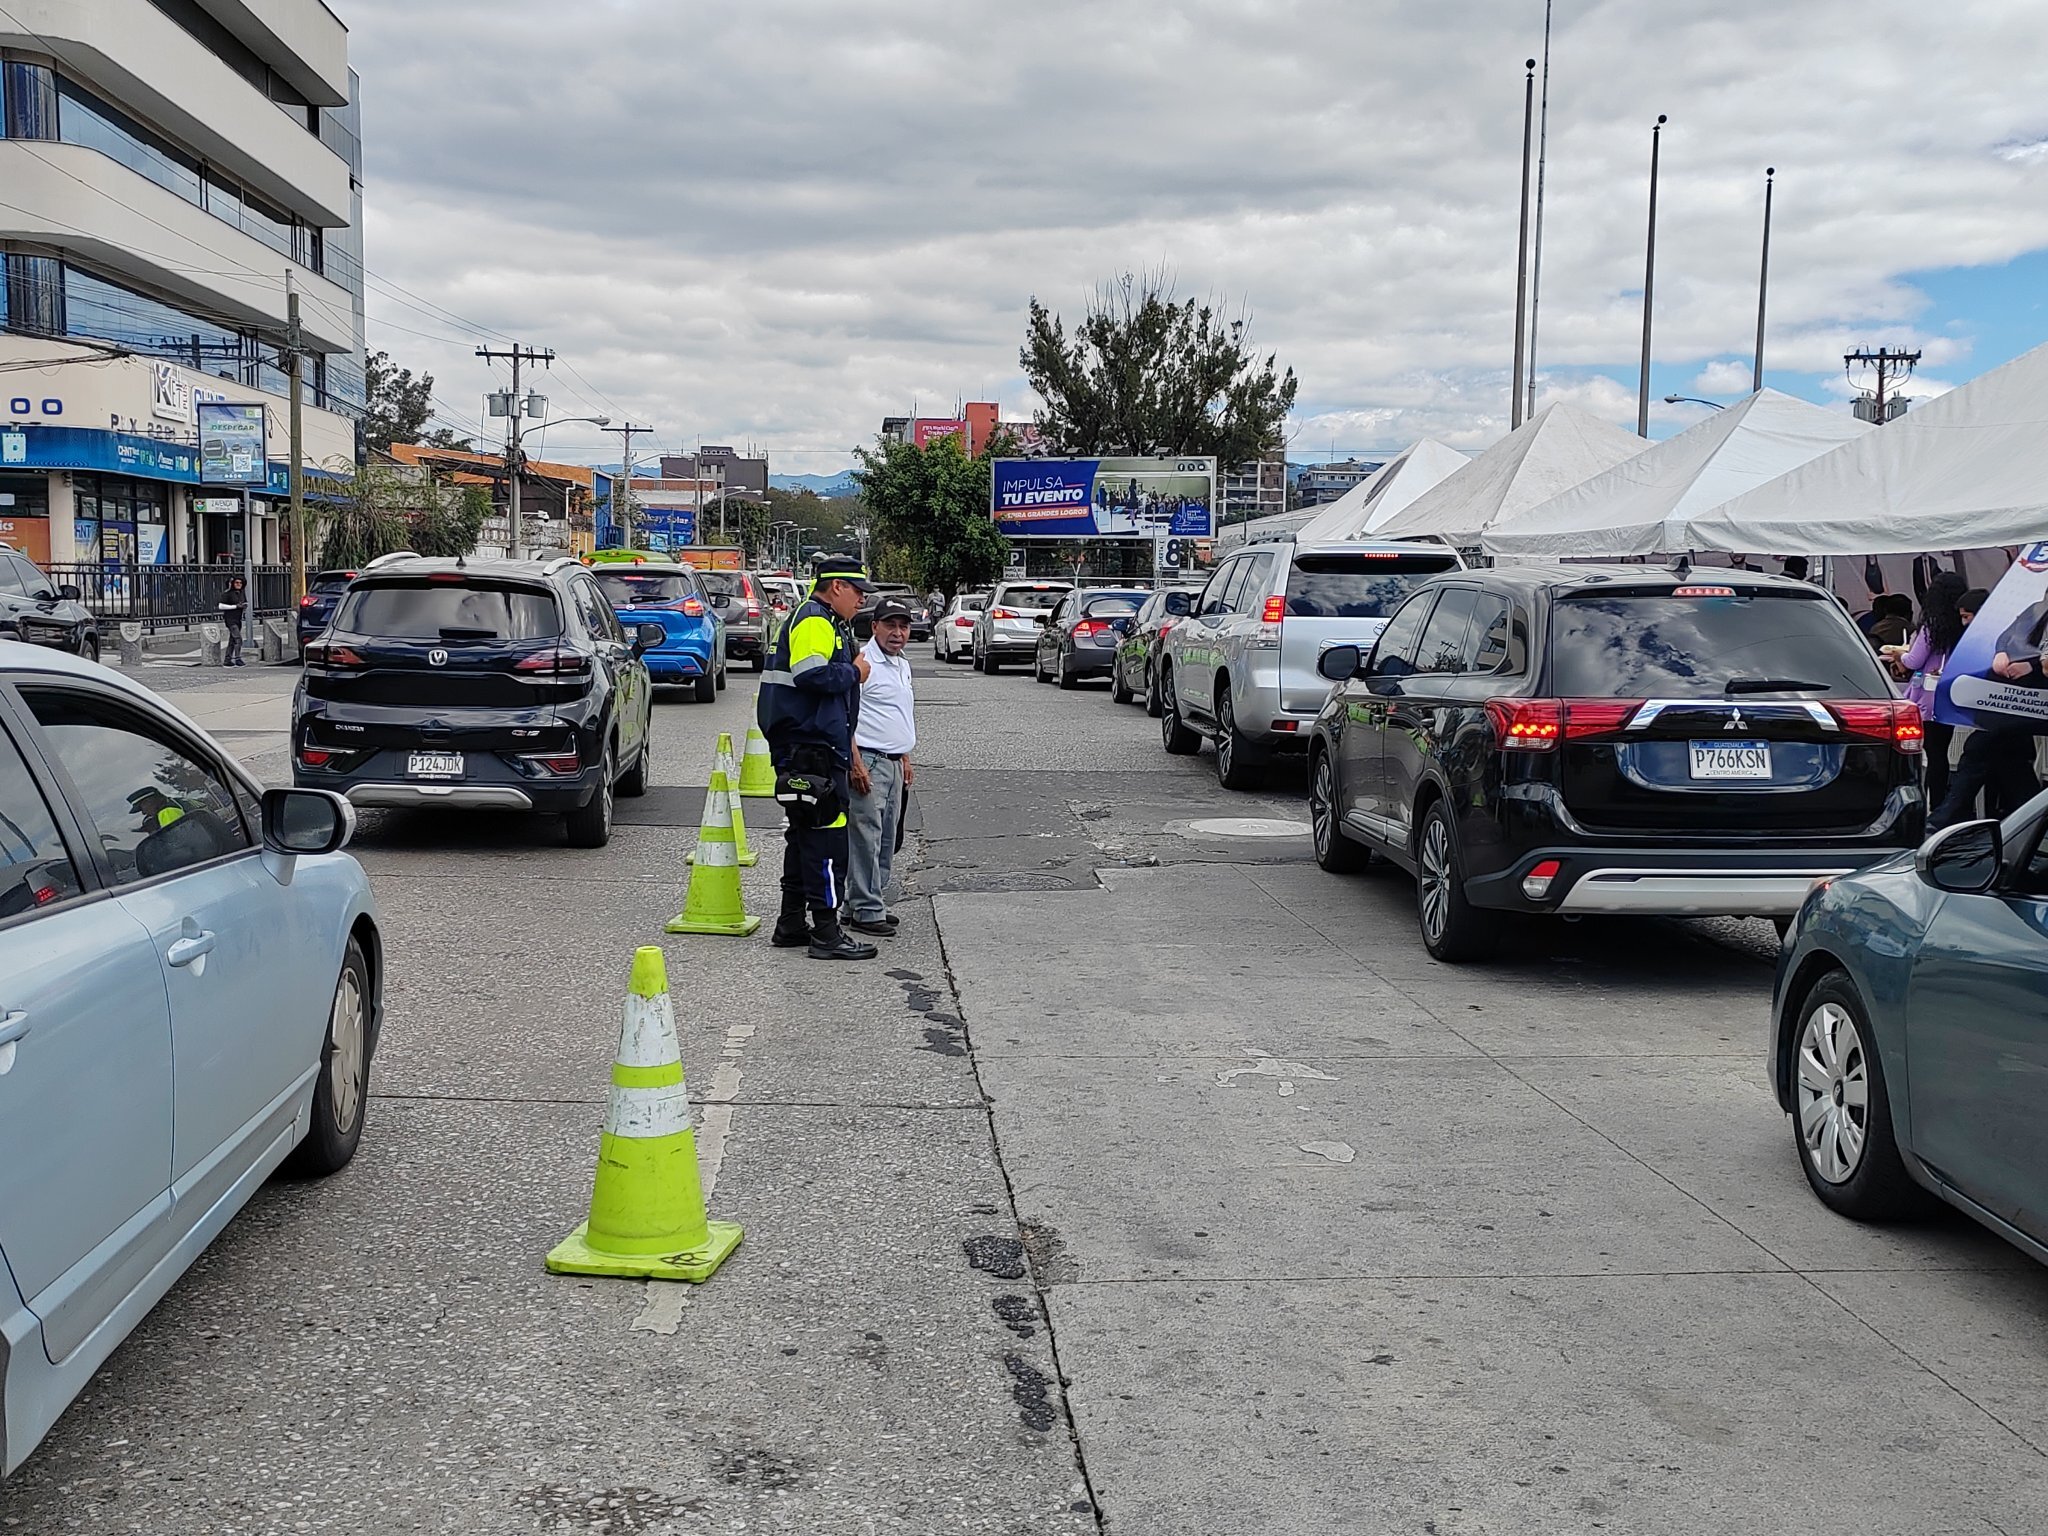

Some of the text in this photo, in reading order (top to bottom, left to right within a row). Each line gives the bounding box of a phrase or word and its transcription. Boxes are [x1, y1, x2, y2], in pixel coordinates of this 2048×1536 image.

[1003, 476, 1064, 492] IMPULSA
[1002, 488, 1084, 505] TU EVENTO
[1027, 510, 1059, 518] GRANDES
[1060, 508, 1088, 516] LOGROS
[1010, 552, 1020, 565] P
[1166, 539, 1180, 566] 8
[1989, 693, 2018, 703] MARÍA
[2004, 687, 2040, 697] TITULAR
[1976, 700, 2010, 709] OVALLE
[410, 757, 461, 771] P124JDK
[1695, 750, 1766, 768] P766KSN
